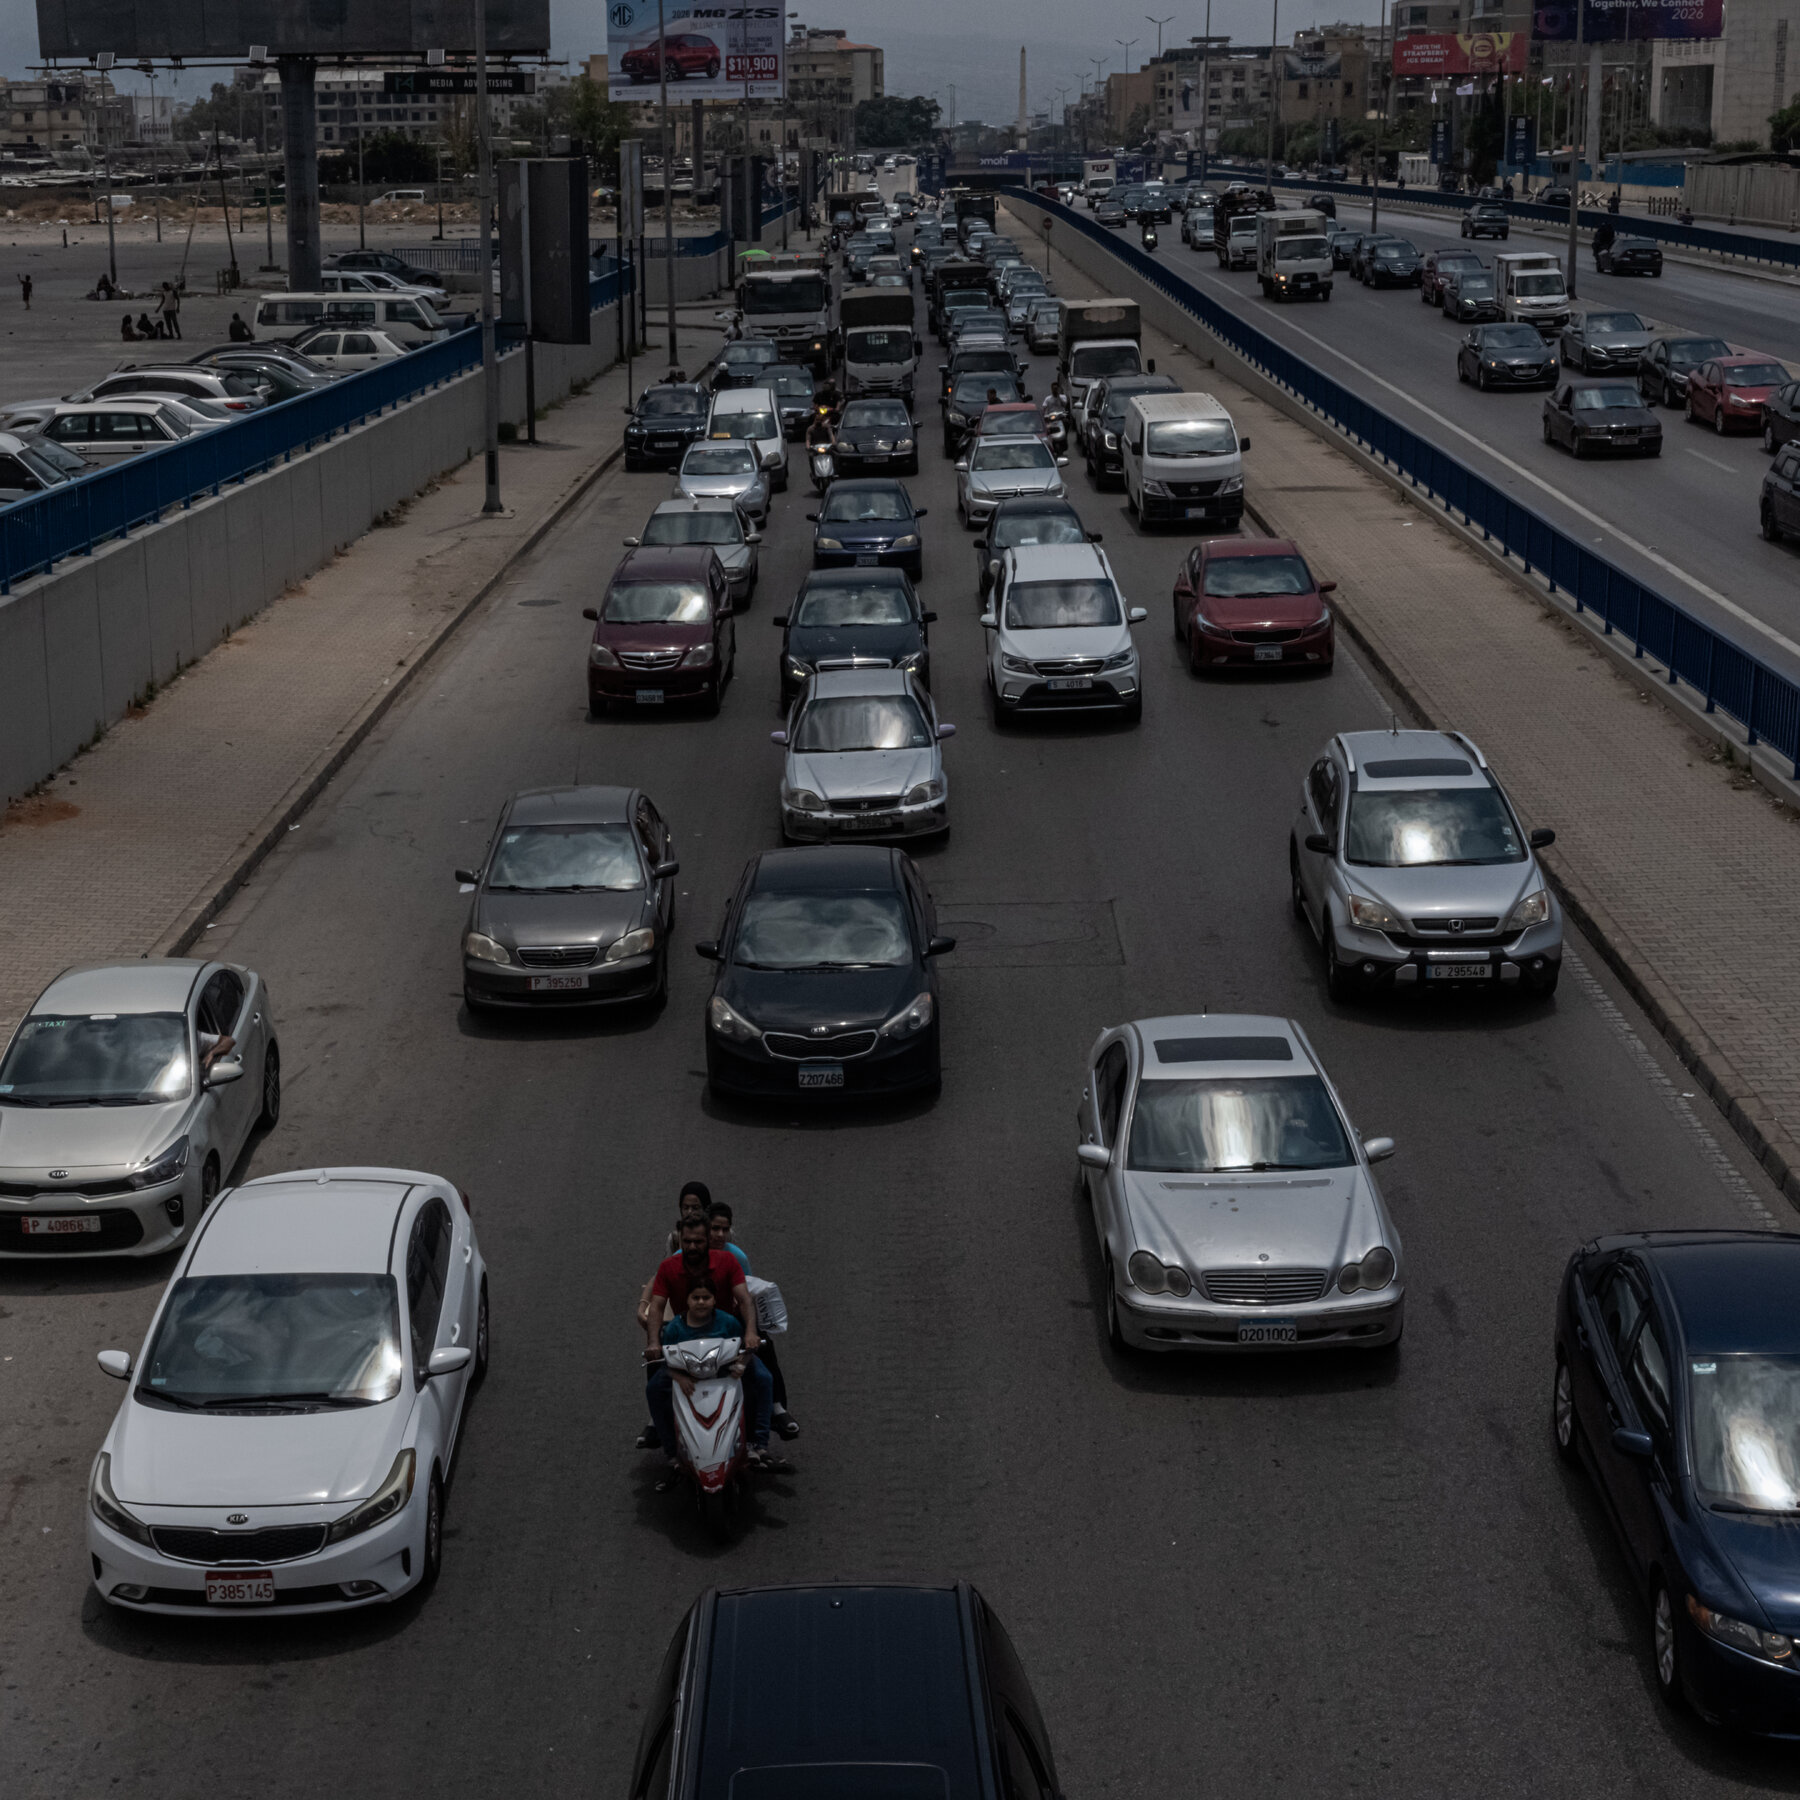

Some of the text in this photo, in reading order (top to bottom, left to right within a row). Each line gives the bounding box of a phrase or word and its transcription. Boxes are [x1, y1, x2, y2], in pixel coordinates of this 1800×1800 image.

[693, 9, 726, 18] MG
[728, 8, 779, 19] ZS
[1671, 8, 1704, 20] 2026
[429, 79, 454, 88] MEDIA
[1447, 966, 1486, 977] 295548
[534, 977, 583, 989] P 395250
[44, 1020, 66, 1028] TAXI
[31, 1220, 40, 1232] P
[228, 1514, 246, 1523] KIA
[207, 1583, 273, 1600] P385145
